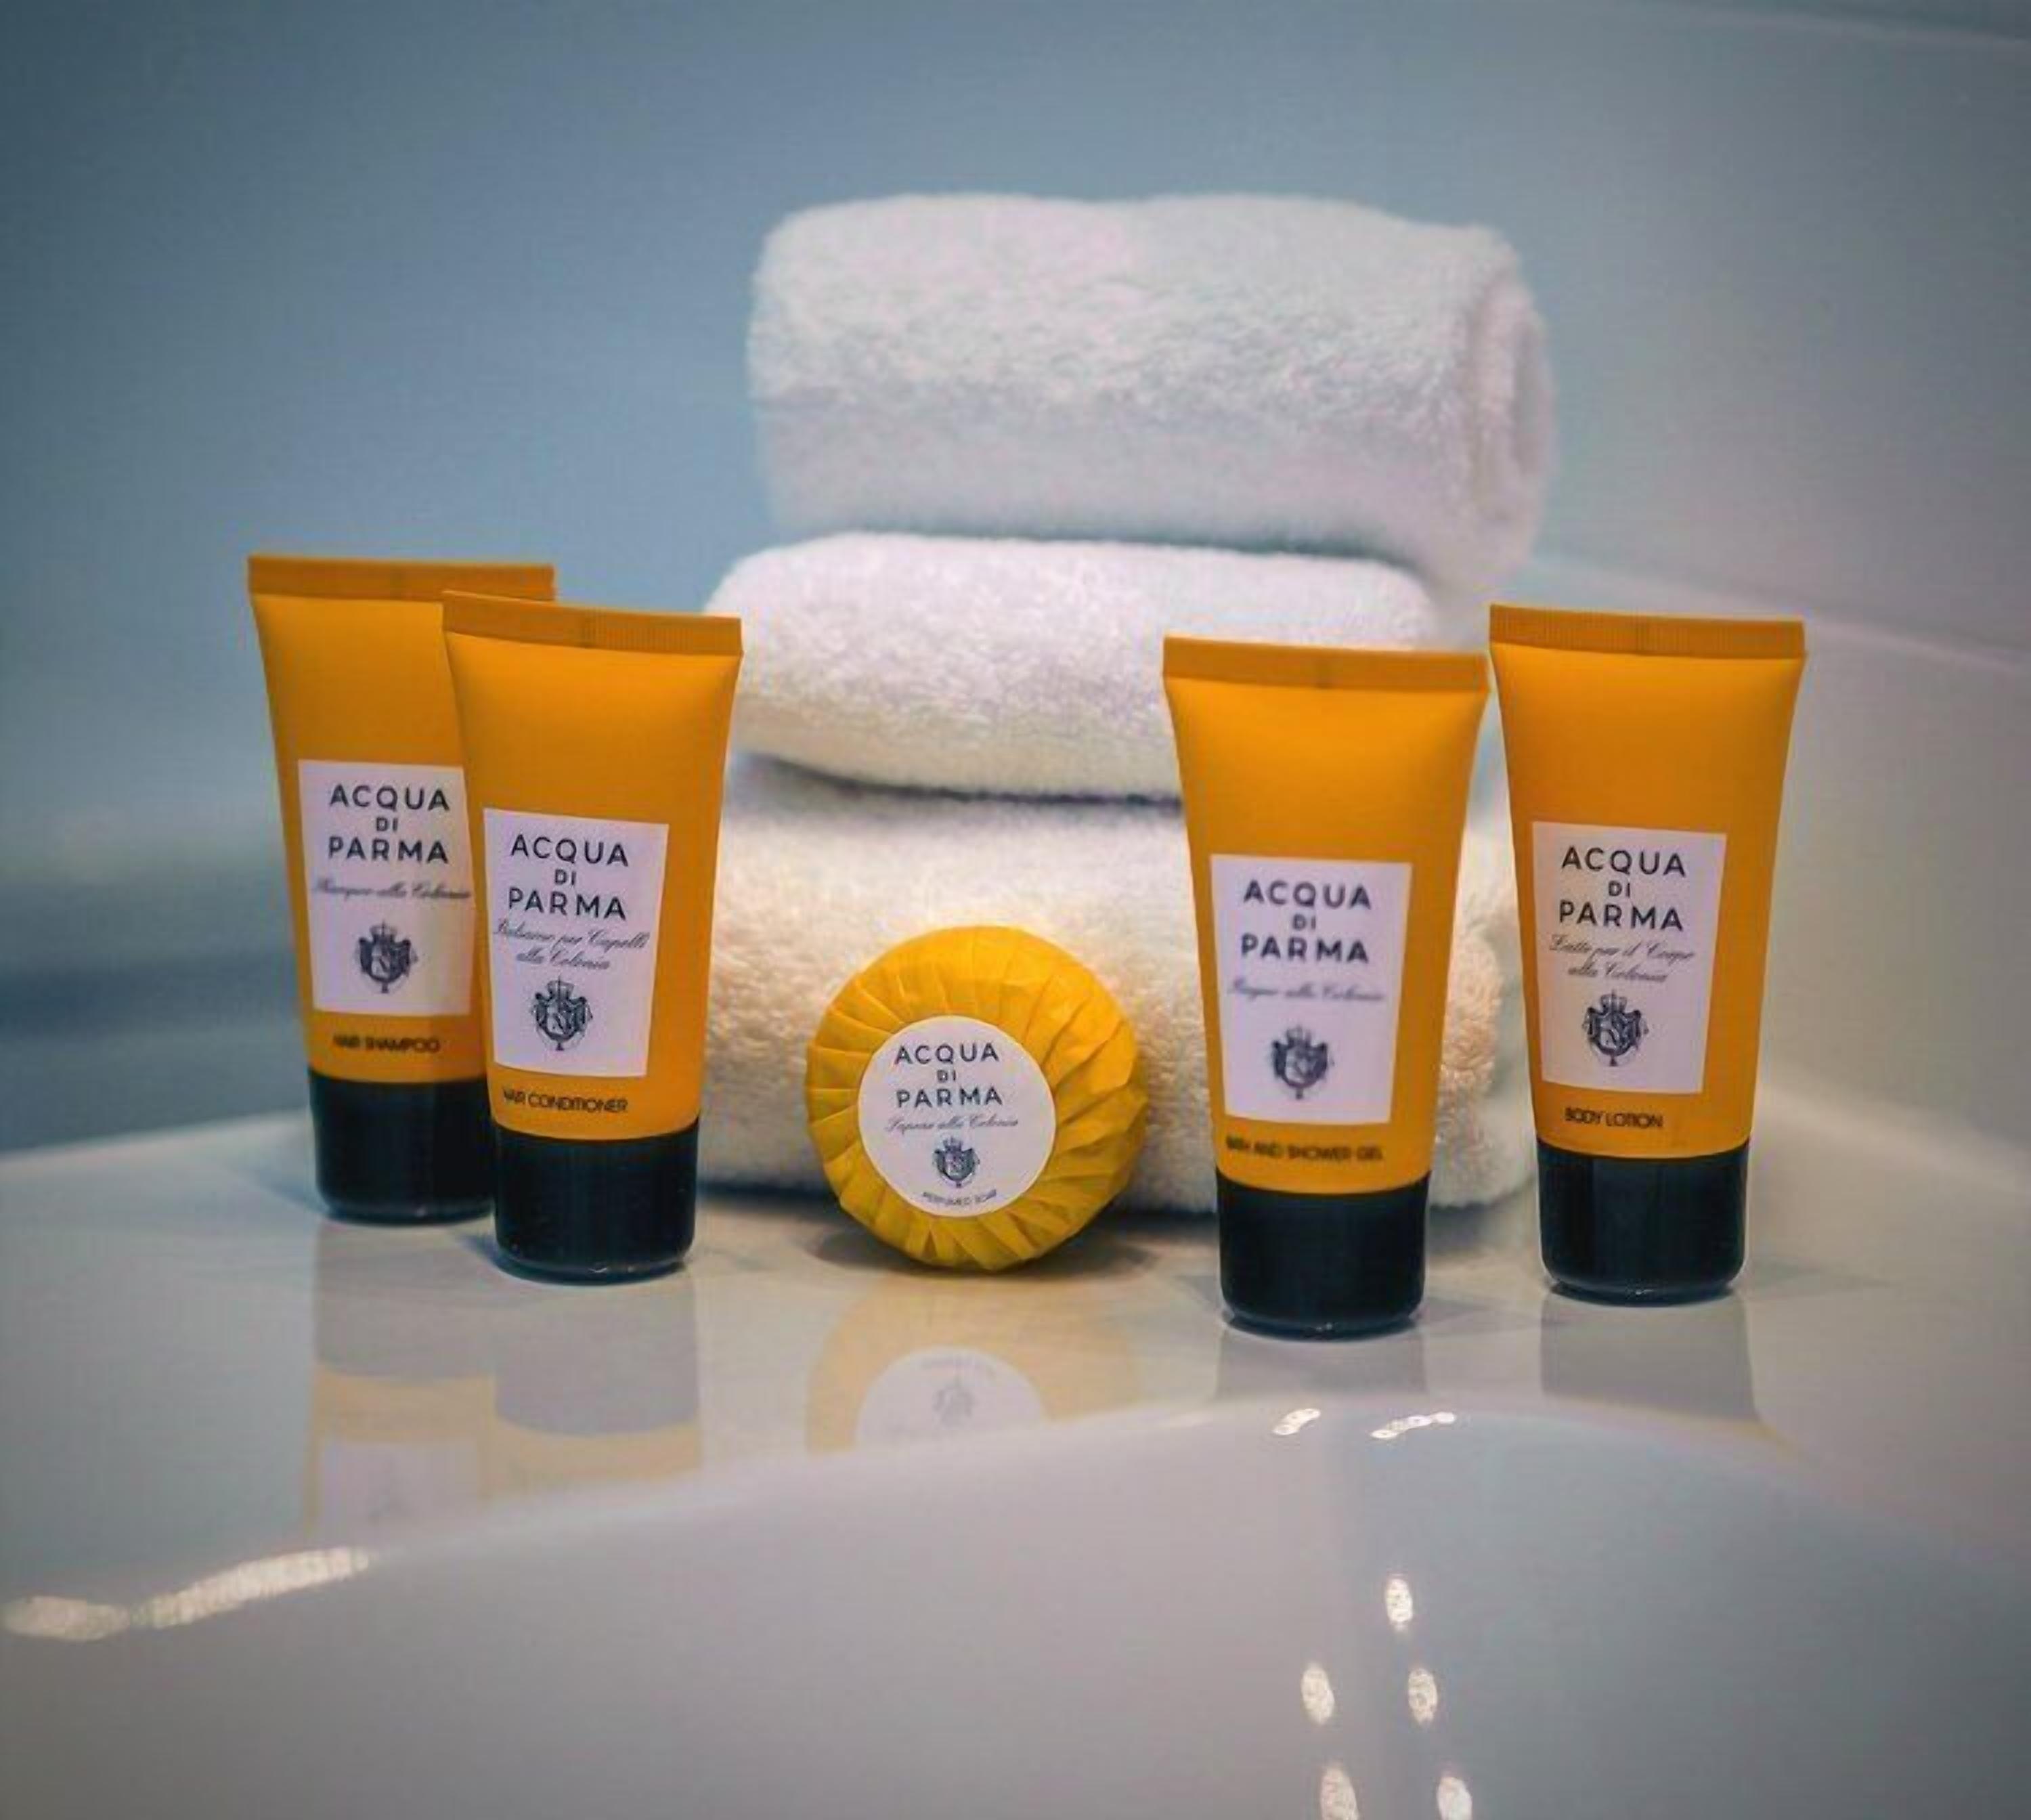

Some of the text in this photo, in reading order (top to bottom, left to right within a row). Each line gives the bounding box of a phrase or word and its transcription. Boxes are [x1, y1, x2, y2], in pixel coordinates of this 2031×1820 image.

[330, 784, 450, 812] ACQUA
[375, 817, 398, 833] DI
[328, 836, 450, 865] PARMA
[510, 833, 629, 867] ACQUA
[1560, 846, 1686, 878] ACQUA
[554, 869, 576, 886] DI
[1608, 881, 1630, 898] DI
[508, 887, 627, 921] PARMA
[1243, 880, 1372, 911] ACQUA
[1292, 914, 1316, 930] DI
[1559, 899, 1684, 931] PARMA
[1241, 933, 1369, 964] PARMA
[894, 1042, 1000, 1065] ACQUA
[937, 1068, 957, 1083] DI
[895, 1086, 1003, 1108] PARMA
[1606, 1112, 1663, 1129] LOTION
